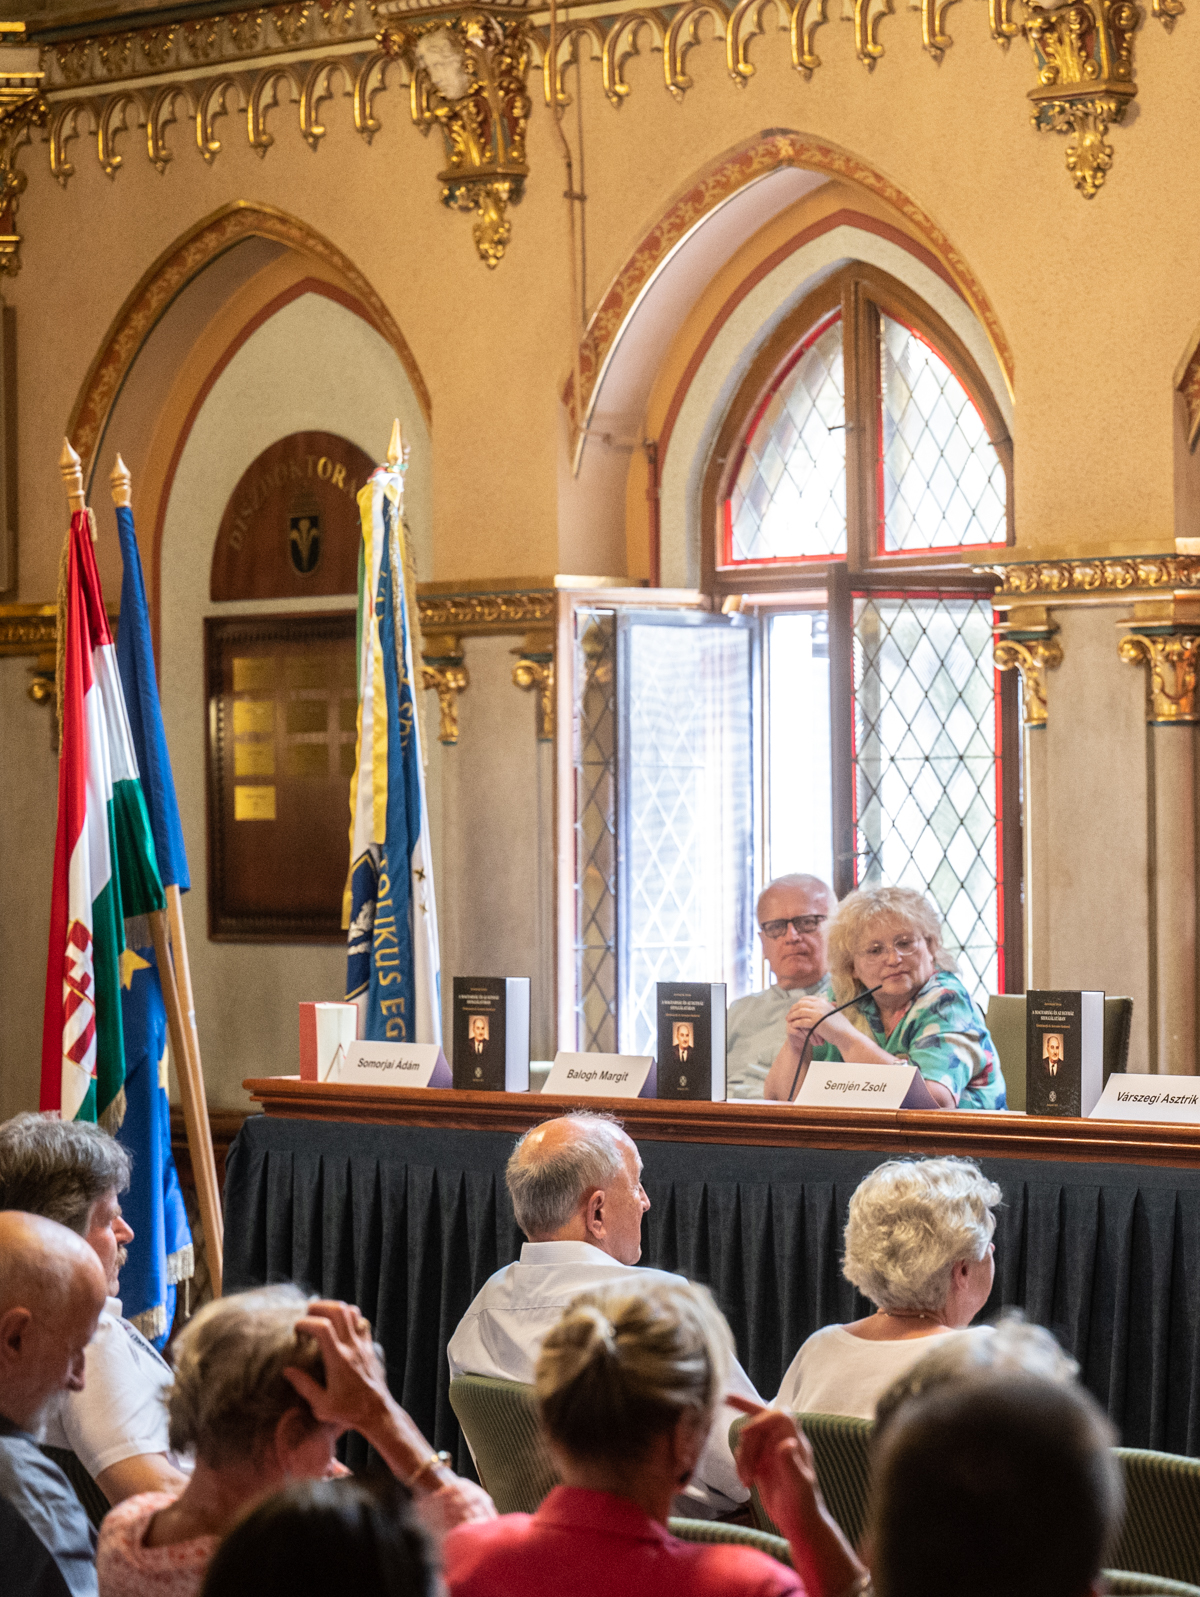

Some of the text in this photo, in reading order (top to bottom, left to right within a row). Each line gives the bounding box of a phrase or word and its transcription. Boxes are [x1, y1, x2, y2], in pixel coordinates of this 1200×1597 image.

[357, 1057, 420, 1071] Somorjai Ádám
[566, 1068, 629, 1083] Balogh Margit
[824, 1079, 887, 1093] Semjén Zsolt
[1116, 1091, 1199, 1105] Várszegi Asztrik
